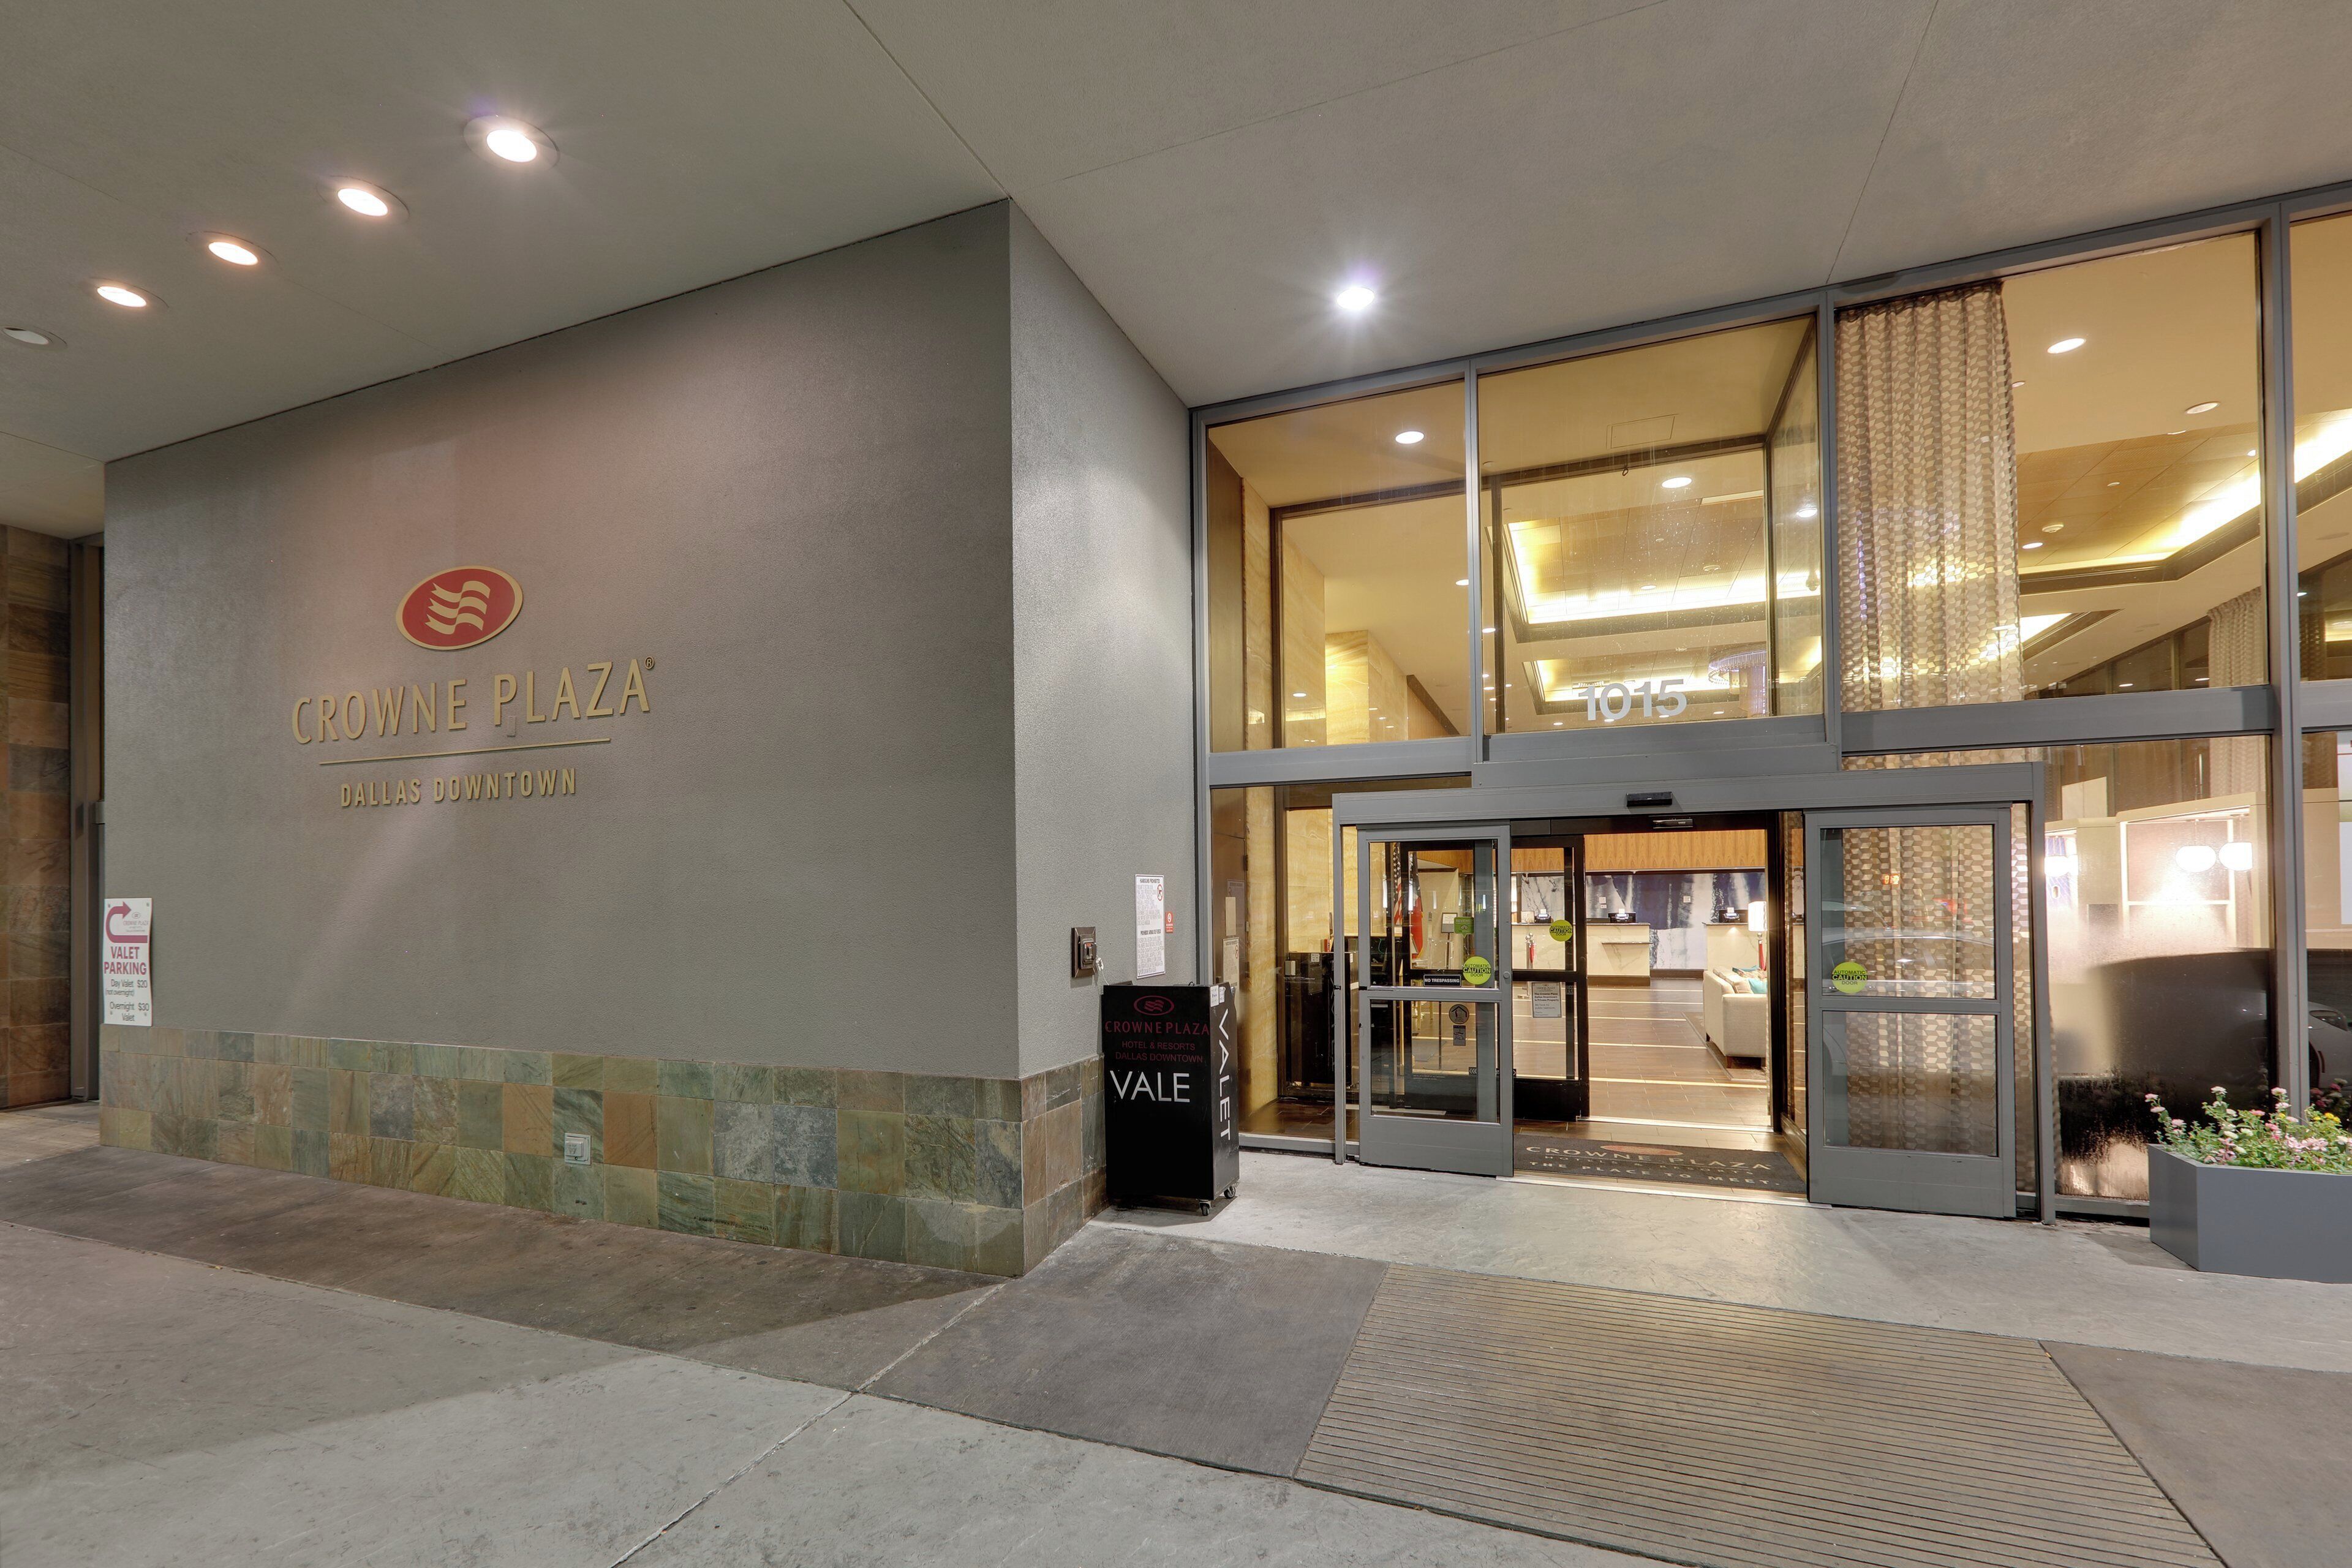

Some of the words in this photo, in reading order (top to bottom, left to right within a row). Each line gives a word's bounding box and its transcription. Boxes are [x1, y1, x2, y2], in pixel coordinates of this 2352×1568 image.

[1578, 679, 1687, 722] 1015
[292, 678, 467, 745] CROWNE
[341, 778, 421, 807] DALLAS
[434, 768, 576, 802] DOWNTOWN
[110, 946, 140, 959] VALET
[104, 961, 147, 975] PARKING
[111, 979, 120, 989] Day
[110, 1001, 134, 1012] Overnight
[138, 1003, 149, 1011] $30
[122, 1012, 135, 1022] Valet
[1105, 1021, 1162, 1034] CROWNE
[1166, 1022, 1210, 1035] PLAZA
[1157, 1042, 1196, 1051] RESORTS
[1115, 1052, 1147, 1061] DALLAS
[1150, 1054, 1204, 1063] DOWNTOWN
[1219, 1008, 1231, 1140] VALET
[1110, 1070, 1190, 1102] VALE
[1526, 1147, 1651, 1161] CROWNE
[1668, 1157, 1771, 1170] PLAZA
[1582, 1166, 1651, 1175] PLACE
